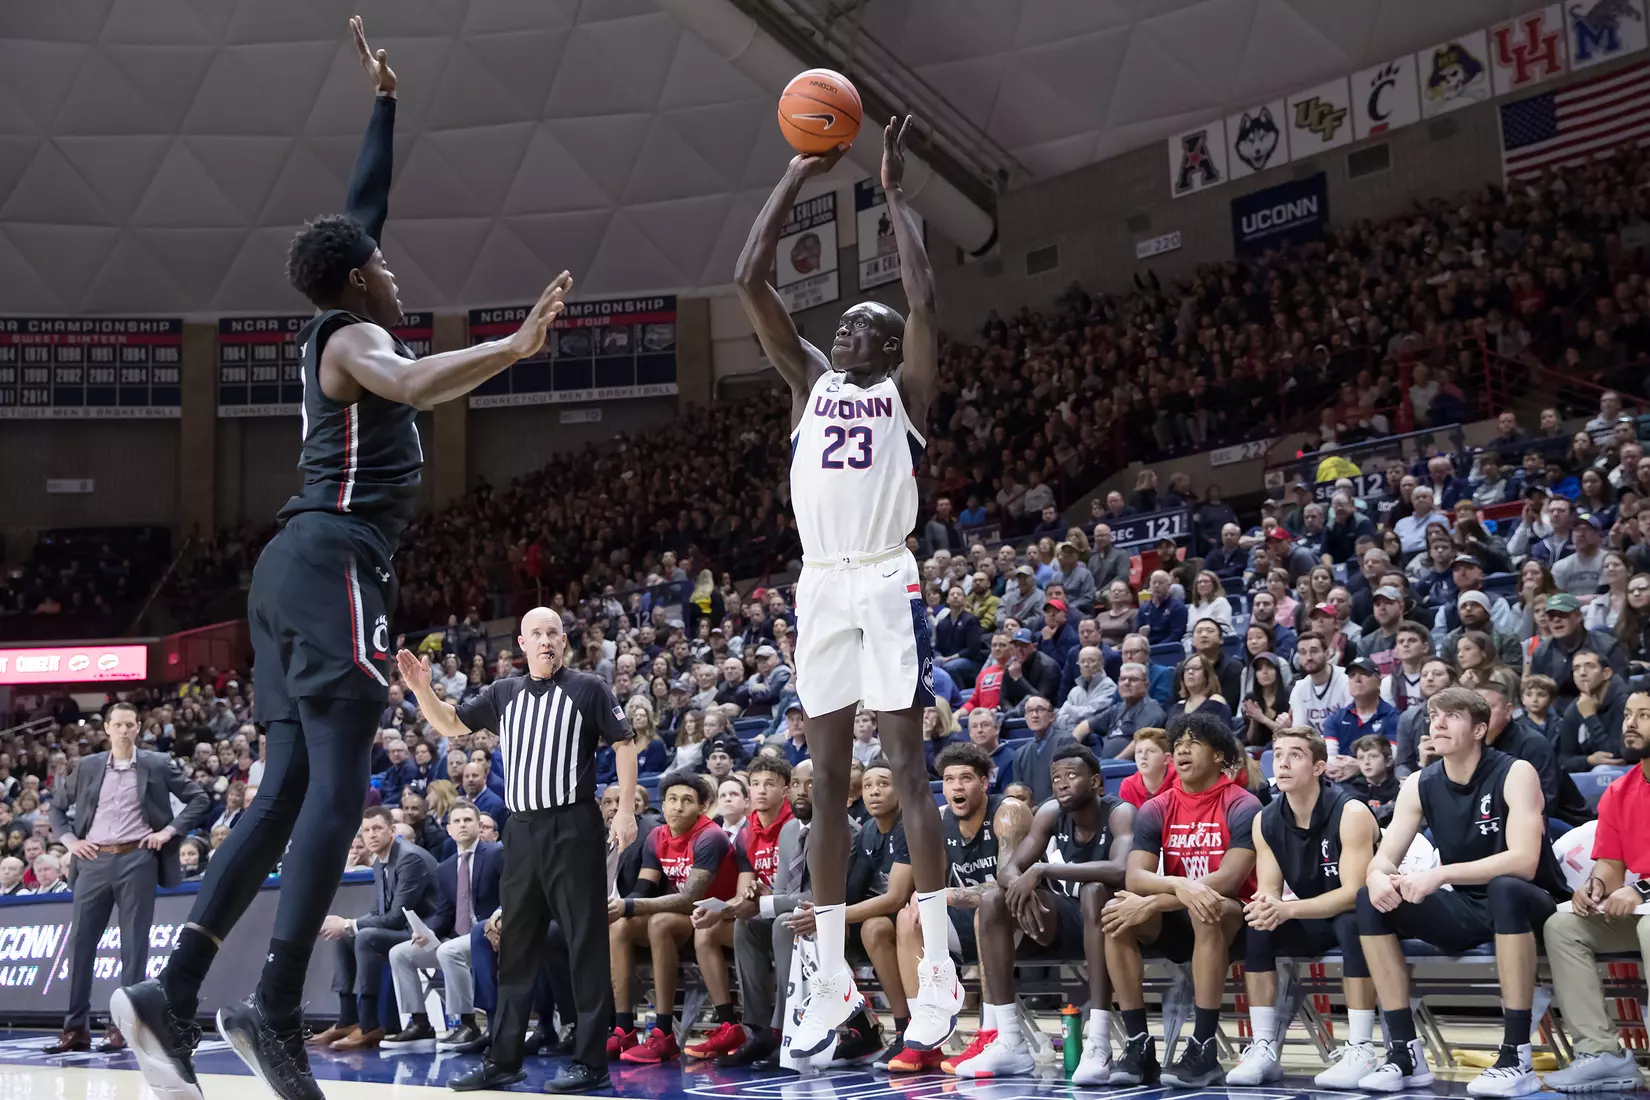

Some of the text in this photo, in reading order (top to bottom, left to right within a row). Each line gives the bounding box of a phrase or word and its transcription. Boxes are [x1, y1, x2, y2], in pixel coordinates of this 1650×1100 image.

[809, 80, 838, 94] UCONN
[1292, 96, 1348, 142] UCF
[1241, 194, 1318, 234] UCONN
[1155, 234, 1180, 251] 220
[481, 299, 664, 322] NCAA AMPIONSHIP
[577, 316, 611, 327] FOUR
[28, 320, 170, 332] CHAMPIONSHIP
[231, 320, 279, 331] NCAA
[224, 407, 299, 416] CONNECTICU
[821, 425, 873, 470] 23
[1316, 473, 1383, 500] SE 12
[1109, 514, 1181, 542] SEC 121
[0, 924, 64, 961] CONN
[0, 965, 39, 986] ALTH
